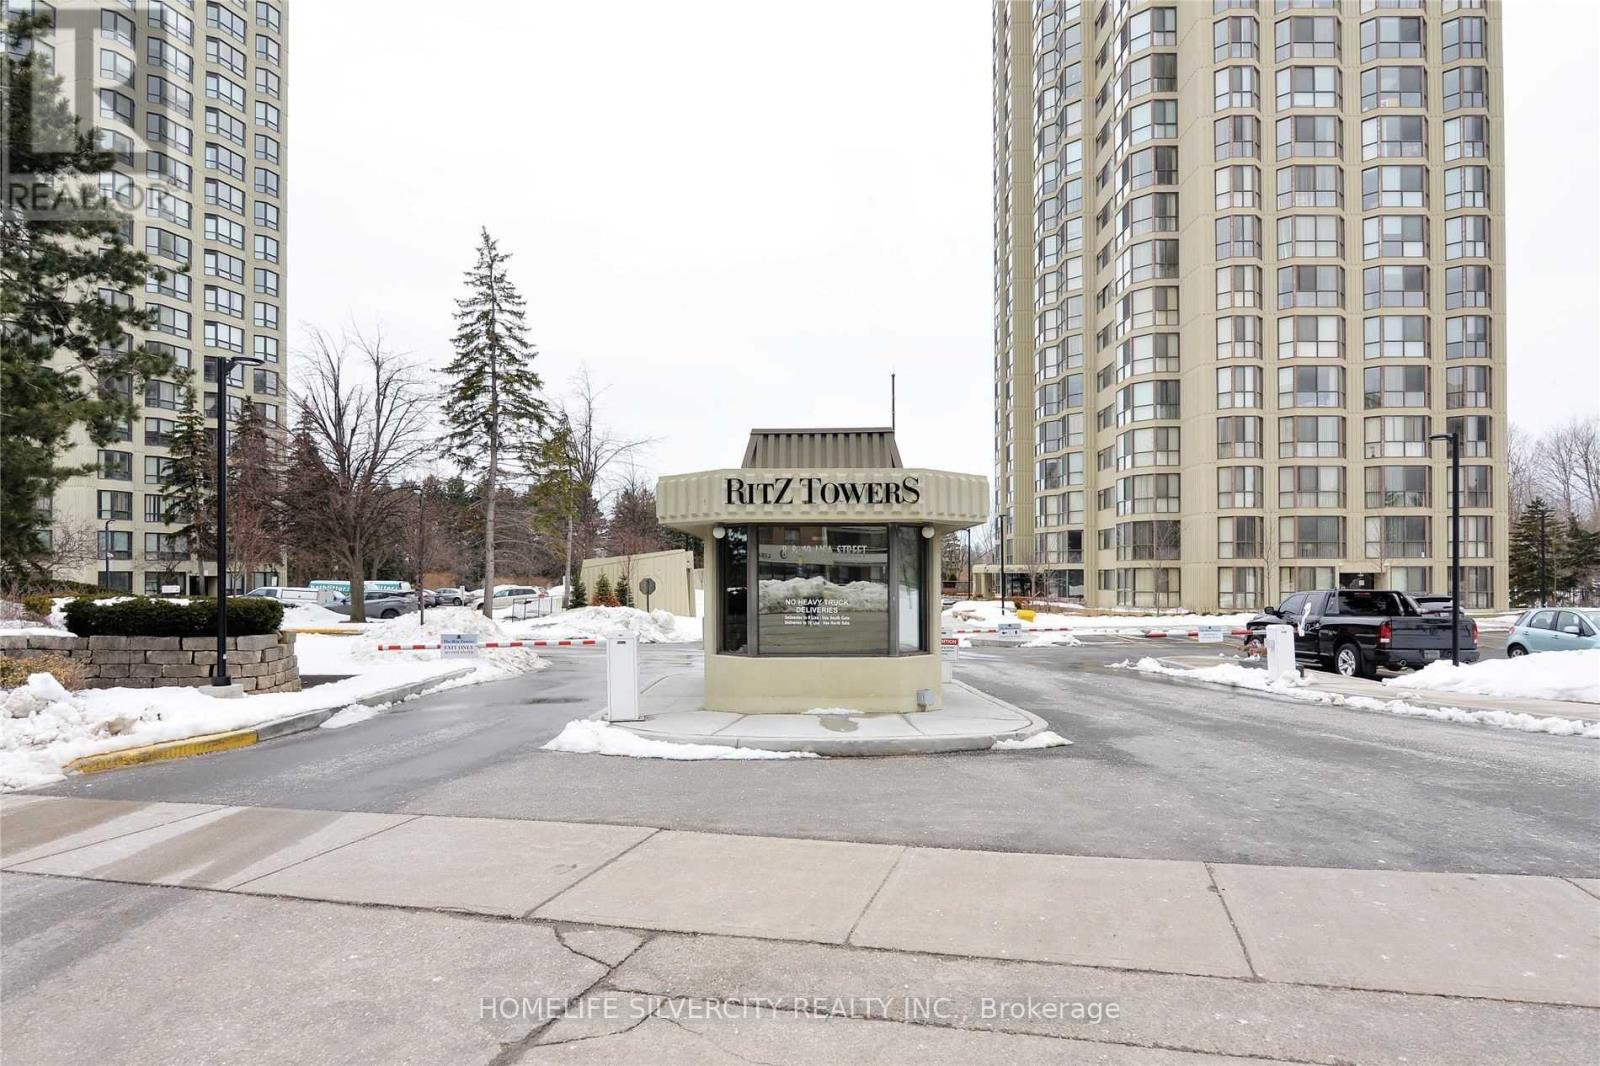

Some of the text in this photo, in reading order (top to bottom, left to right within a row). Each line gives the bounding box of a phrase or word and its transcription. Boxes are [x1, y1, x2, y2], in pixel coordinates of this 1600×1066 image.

[724, 476, 921, 505] RITZ TOWERS
[837, 545, 867, 554] STREET
